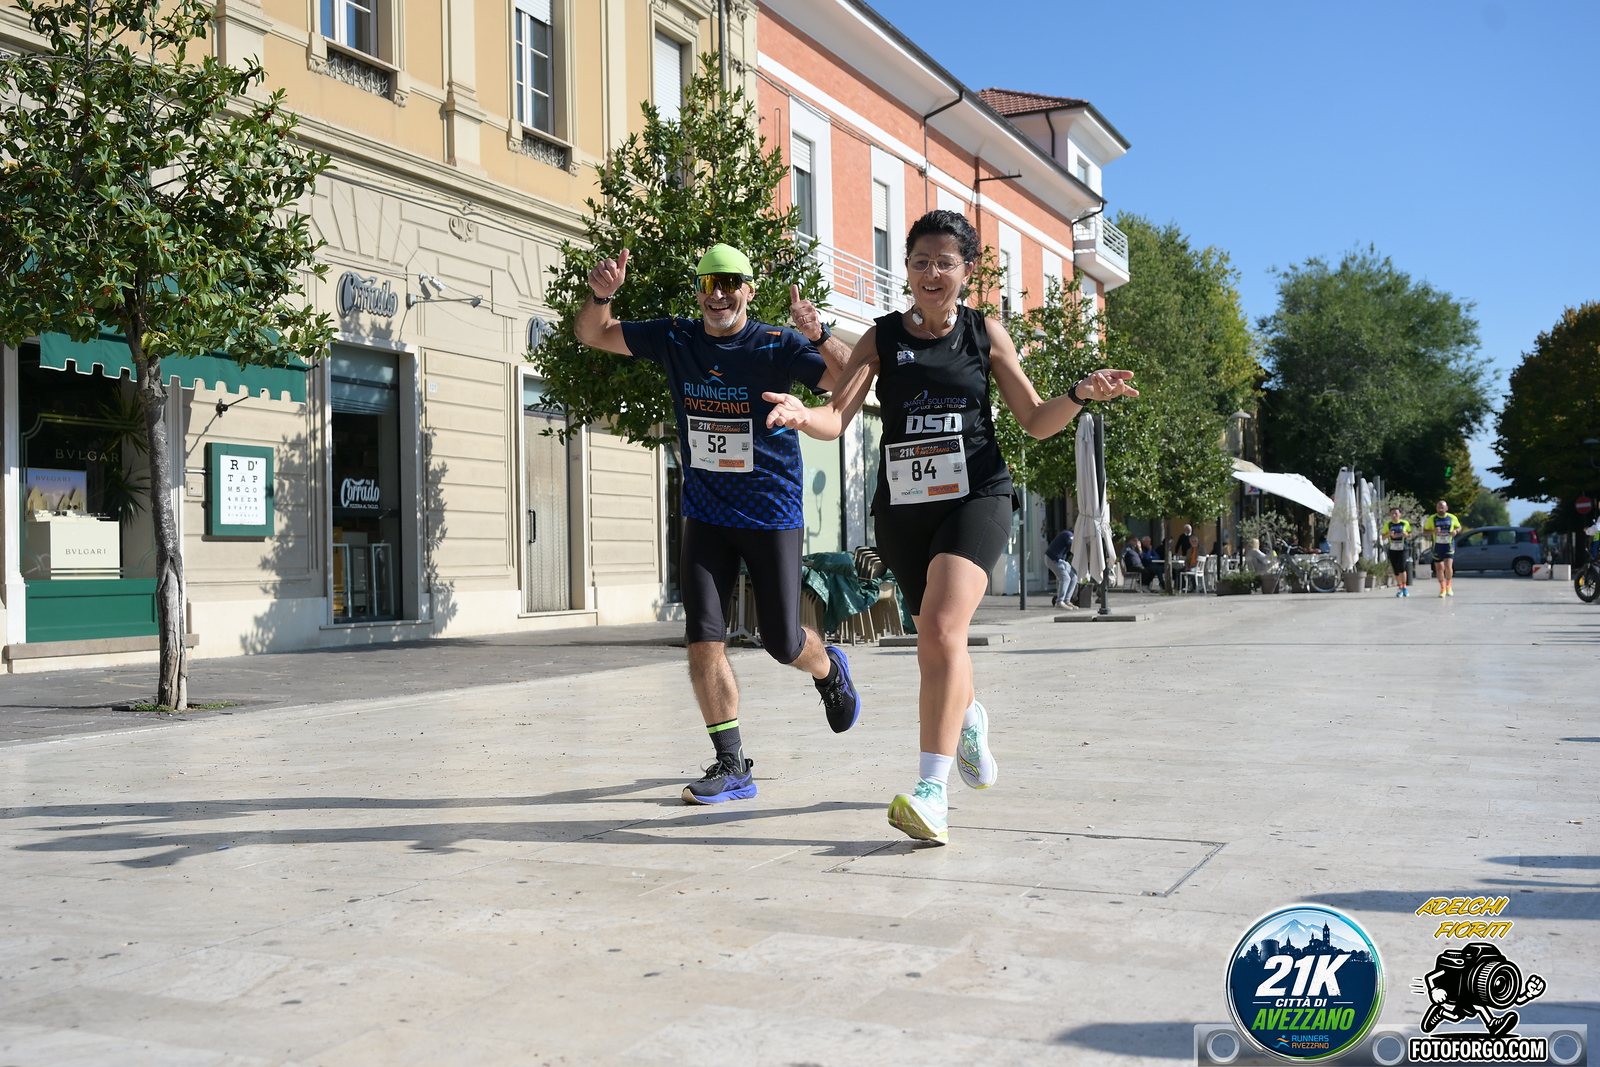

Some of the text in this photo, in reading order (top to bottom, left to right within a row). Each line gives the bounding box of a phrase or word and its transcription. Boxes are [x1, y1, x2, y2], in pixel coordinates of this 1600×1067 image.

[336, 271, 398, 318] Corrado
[683, 382, 749, 400] RUNNERS
[684, 397, 750, 414] AVEZZANO
[927, 397, 967, 405] SOLUTIONS
[697, 421, 711, 431] 21K
[905, 412, 963, 434] DSD
[707, 434, 727, 453] 52
[55, 448, 119, 463] BVLGAR
[899, 447, 915, 458] 21K
[230, 459, 239, 471] R
[911, 458, 937, 481] 84
[227, 474, 234, 482] T
[252, 475, 258, 483] P
[340, 478, 380, 508] Corrado
